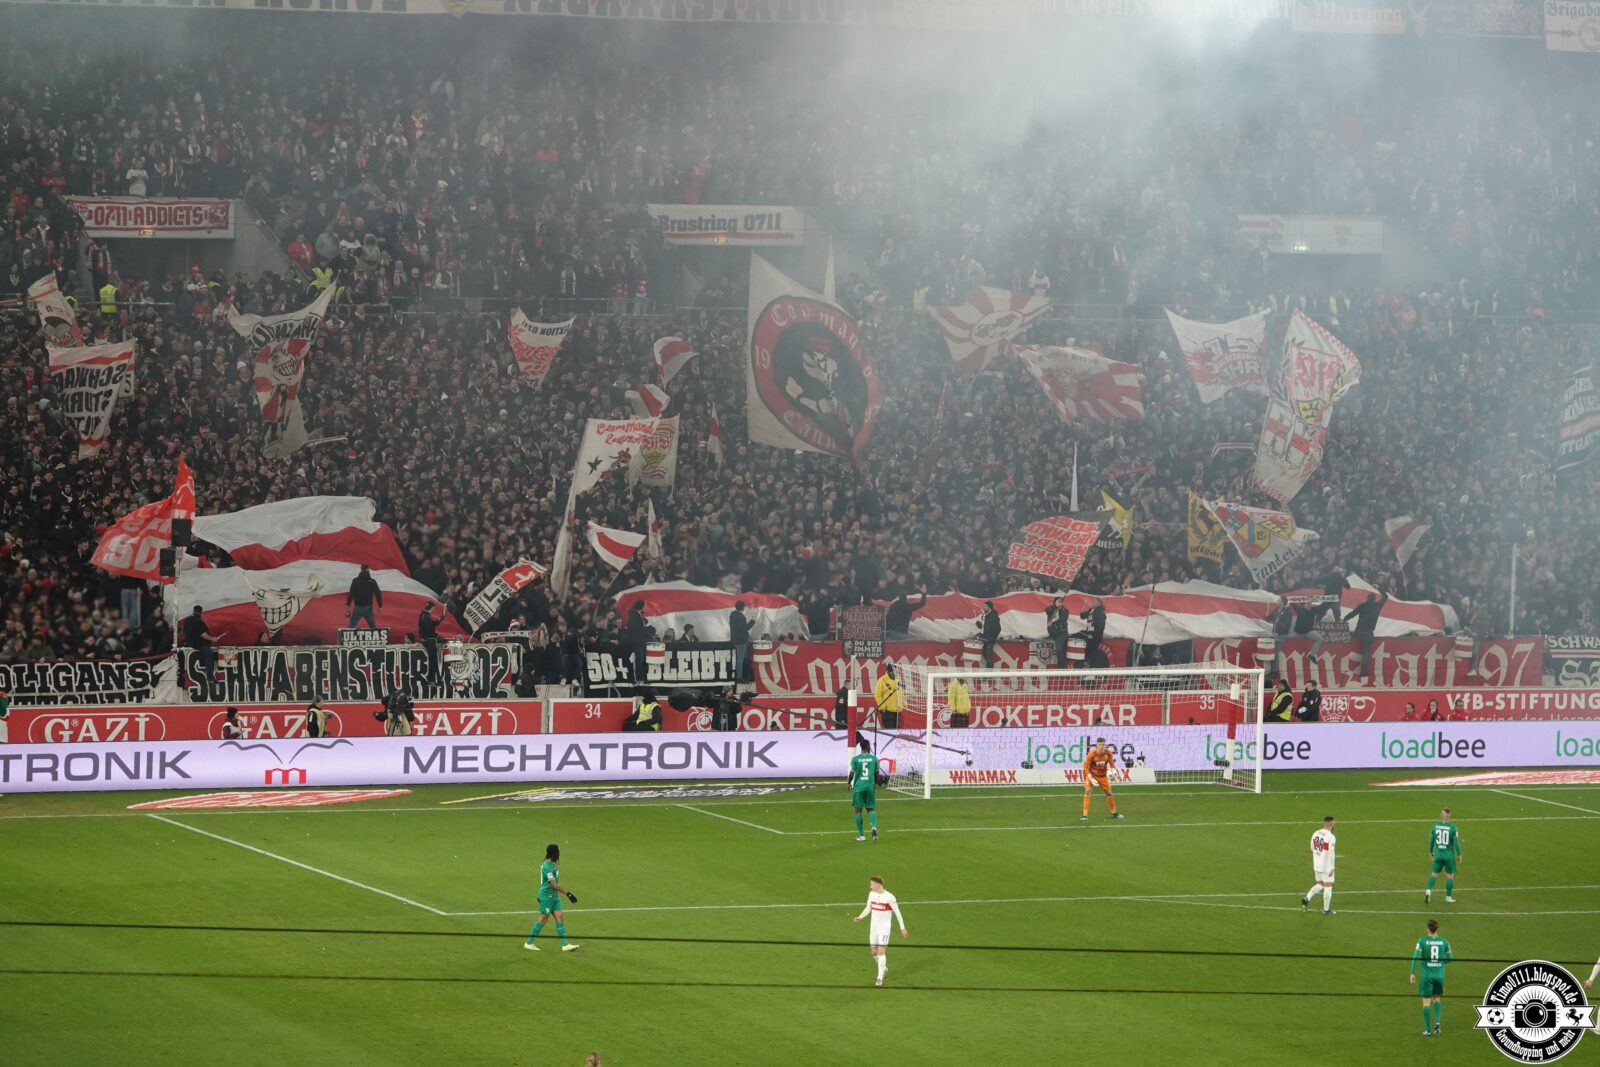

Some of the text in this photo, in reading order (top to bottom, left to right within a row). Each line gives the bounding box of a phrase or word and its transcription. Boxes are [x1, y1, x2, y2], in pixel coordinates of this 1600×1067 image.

[94, 205, 204, 226] 0711 ADDICTS
[658, 213, 782, 237] Brustring 0711
[343, 629, 388, 641] ULTRAS
[1478, 642, 1536, 688] 97
[585, 703, 602, 719] 34
[1199, 695, 1215, 710] 35
[967, 703, 1137, 729] JOKERSTAR
[1381, 731, 1487, 759] loadbee
[403, 740, 779, 775] MECHATRONIK
[862, 762, 869, 777] 5
[949, 769, 1018, 784] WINAMAX
[1435, 829, 1449, 846] 30
